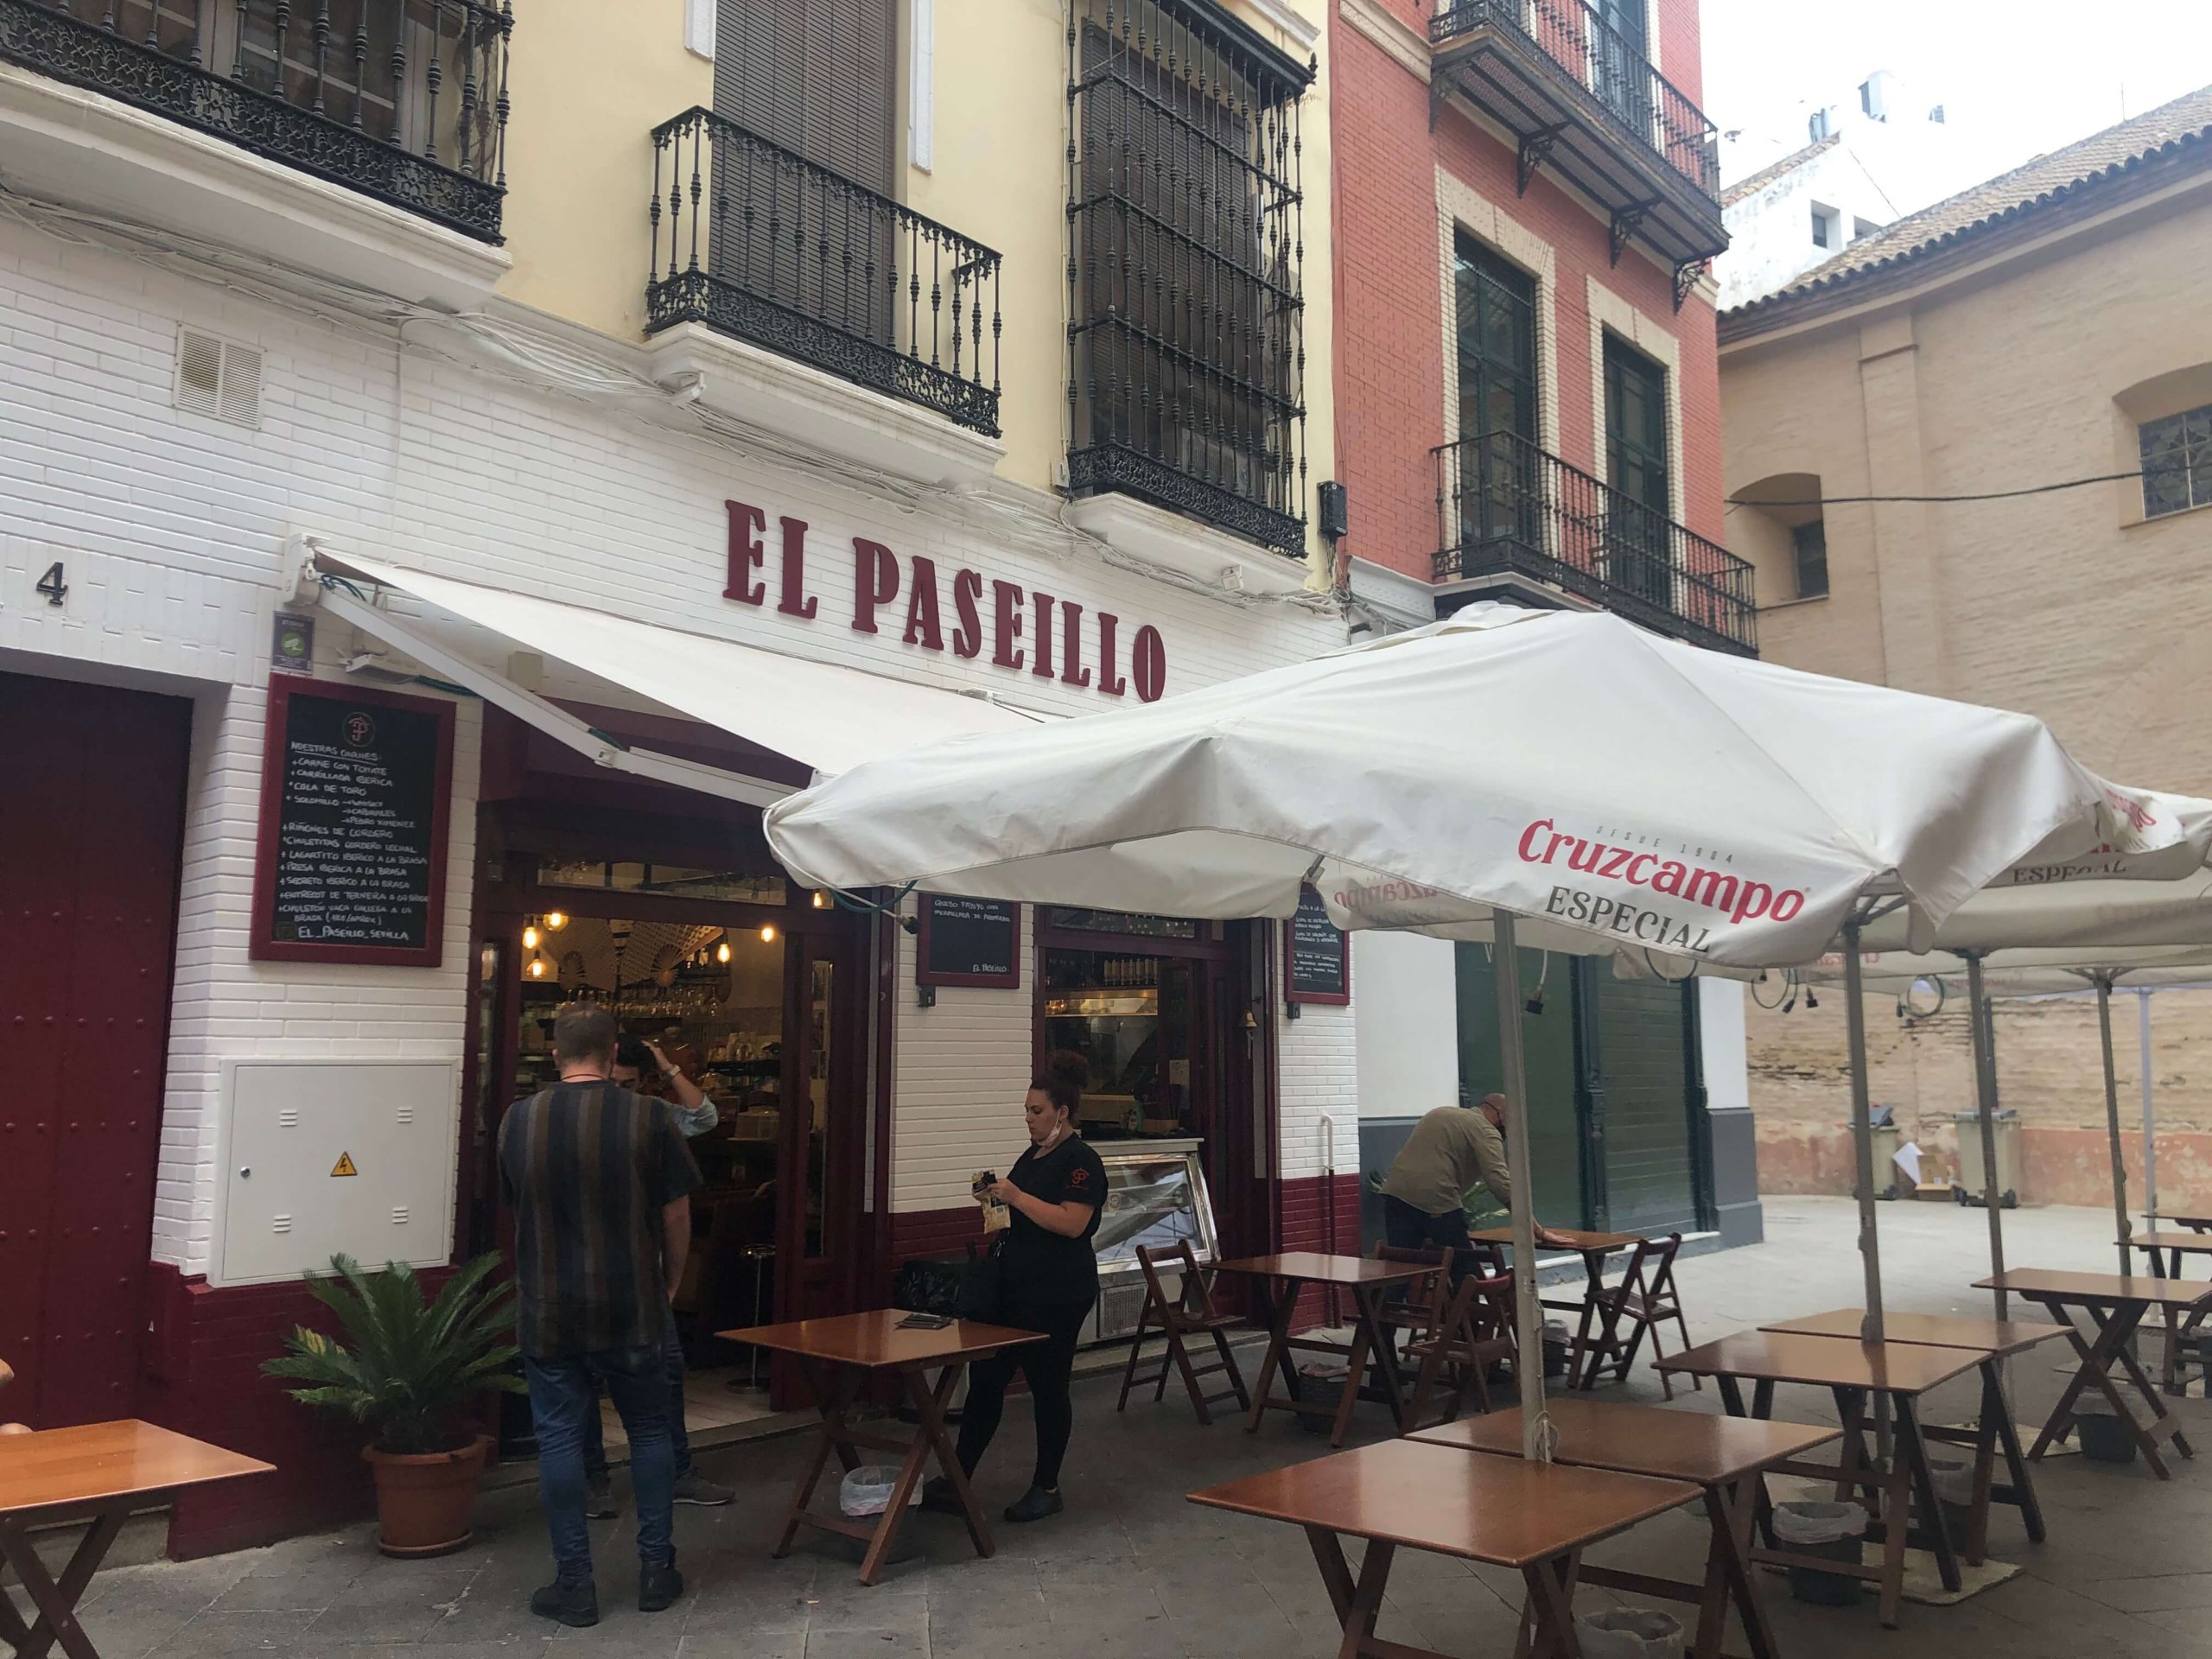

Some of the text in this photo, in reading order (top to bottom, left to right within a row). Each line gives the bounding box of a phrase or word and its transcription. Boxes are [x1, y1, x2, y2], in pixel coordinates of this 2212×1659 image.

[36, 562, 68, 606] 4
[722, 499, 1166, 703] EL PASEILLO
[324, 785, 338, 793] DE
[340, 785, 367, 797] TORO
[1596, 825, 1734, 864] DESDE 1904
[1518, 818, 1806, 925] Cruzcampo
[1545, 885, 1713, 954] ESPECIAL
[972, 963, 982, 972] EL
